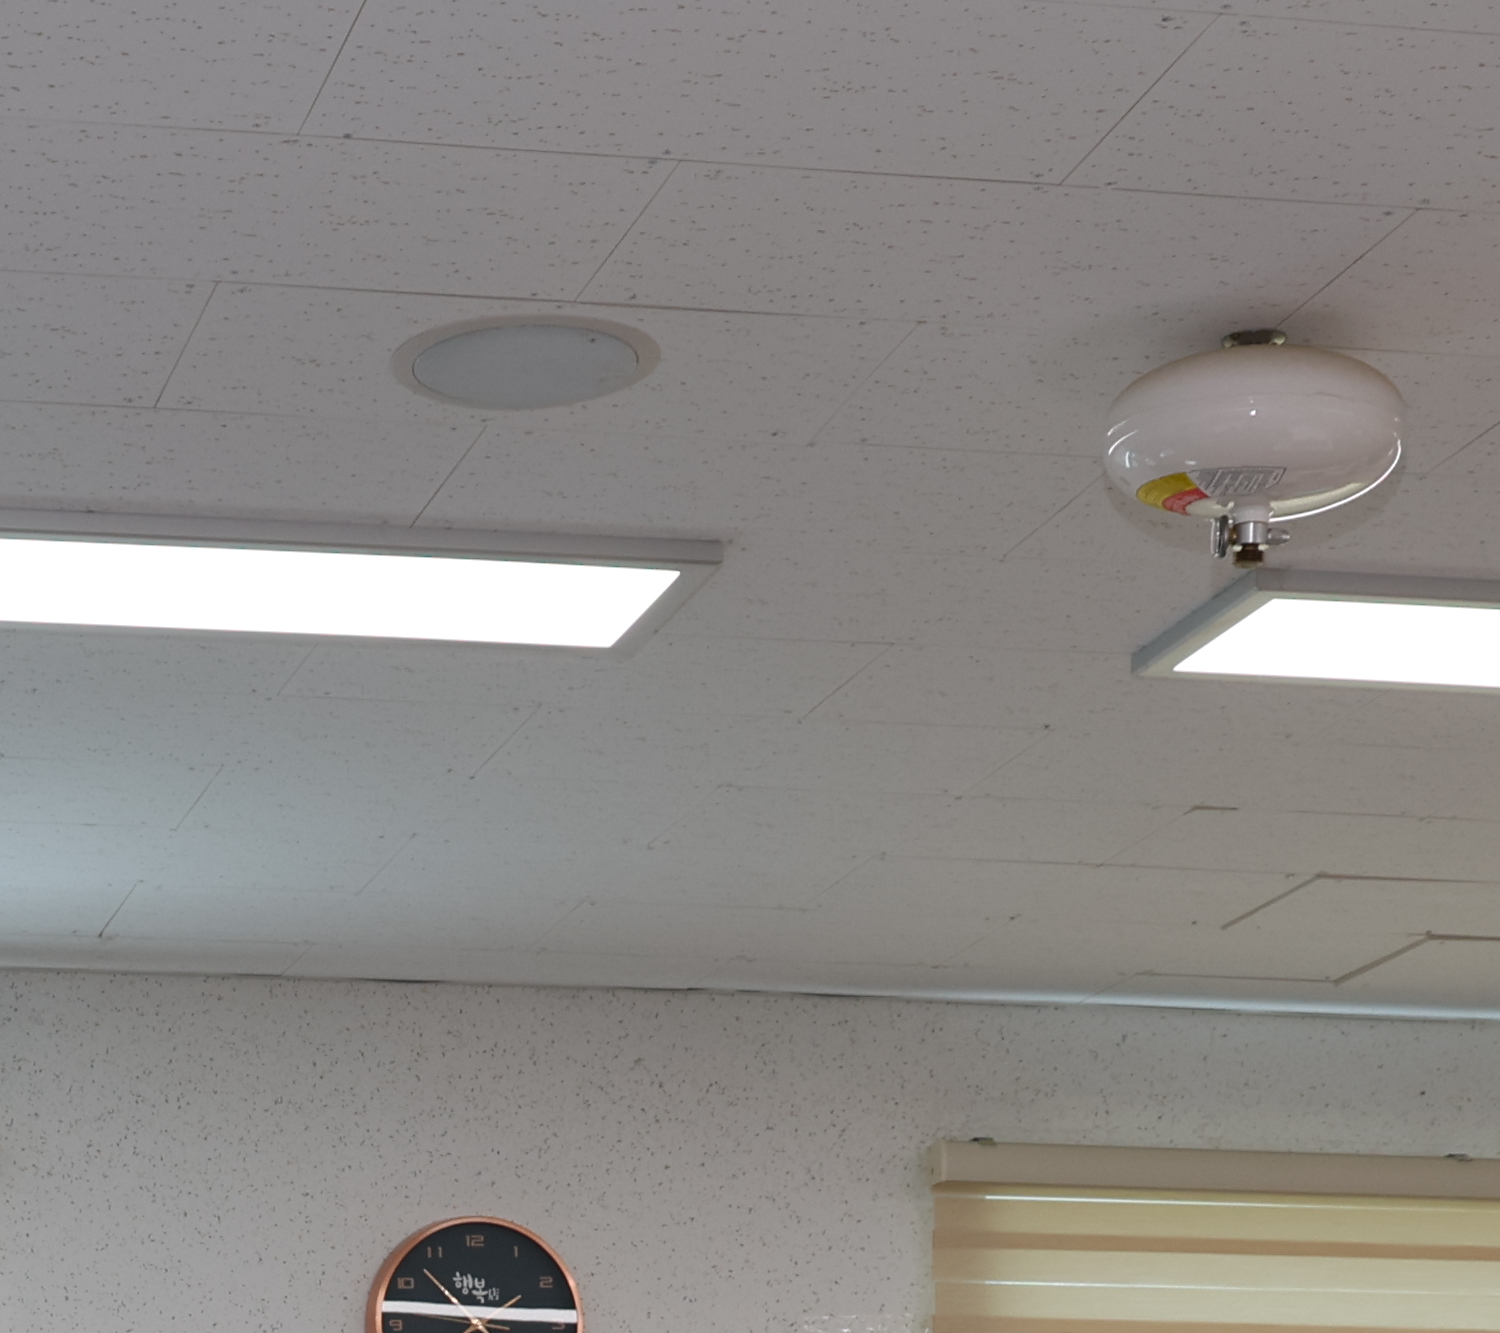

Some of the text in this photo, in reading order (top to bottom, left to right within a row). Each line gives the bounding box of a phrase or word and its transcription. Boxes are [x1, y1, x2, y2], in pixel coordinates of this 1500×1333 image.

[465, 1234, 484, 1247] 12
[397, 1277, 415, 1289] 10
[539, 1276, 553, 1288] 2
